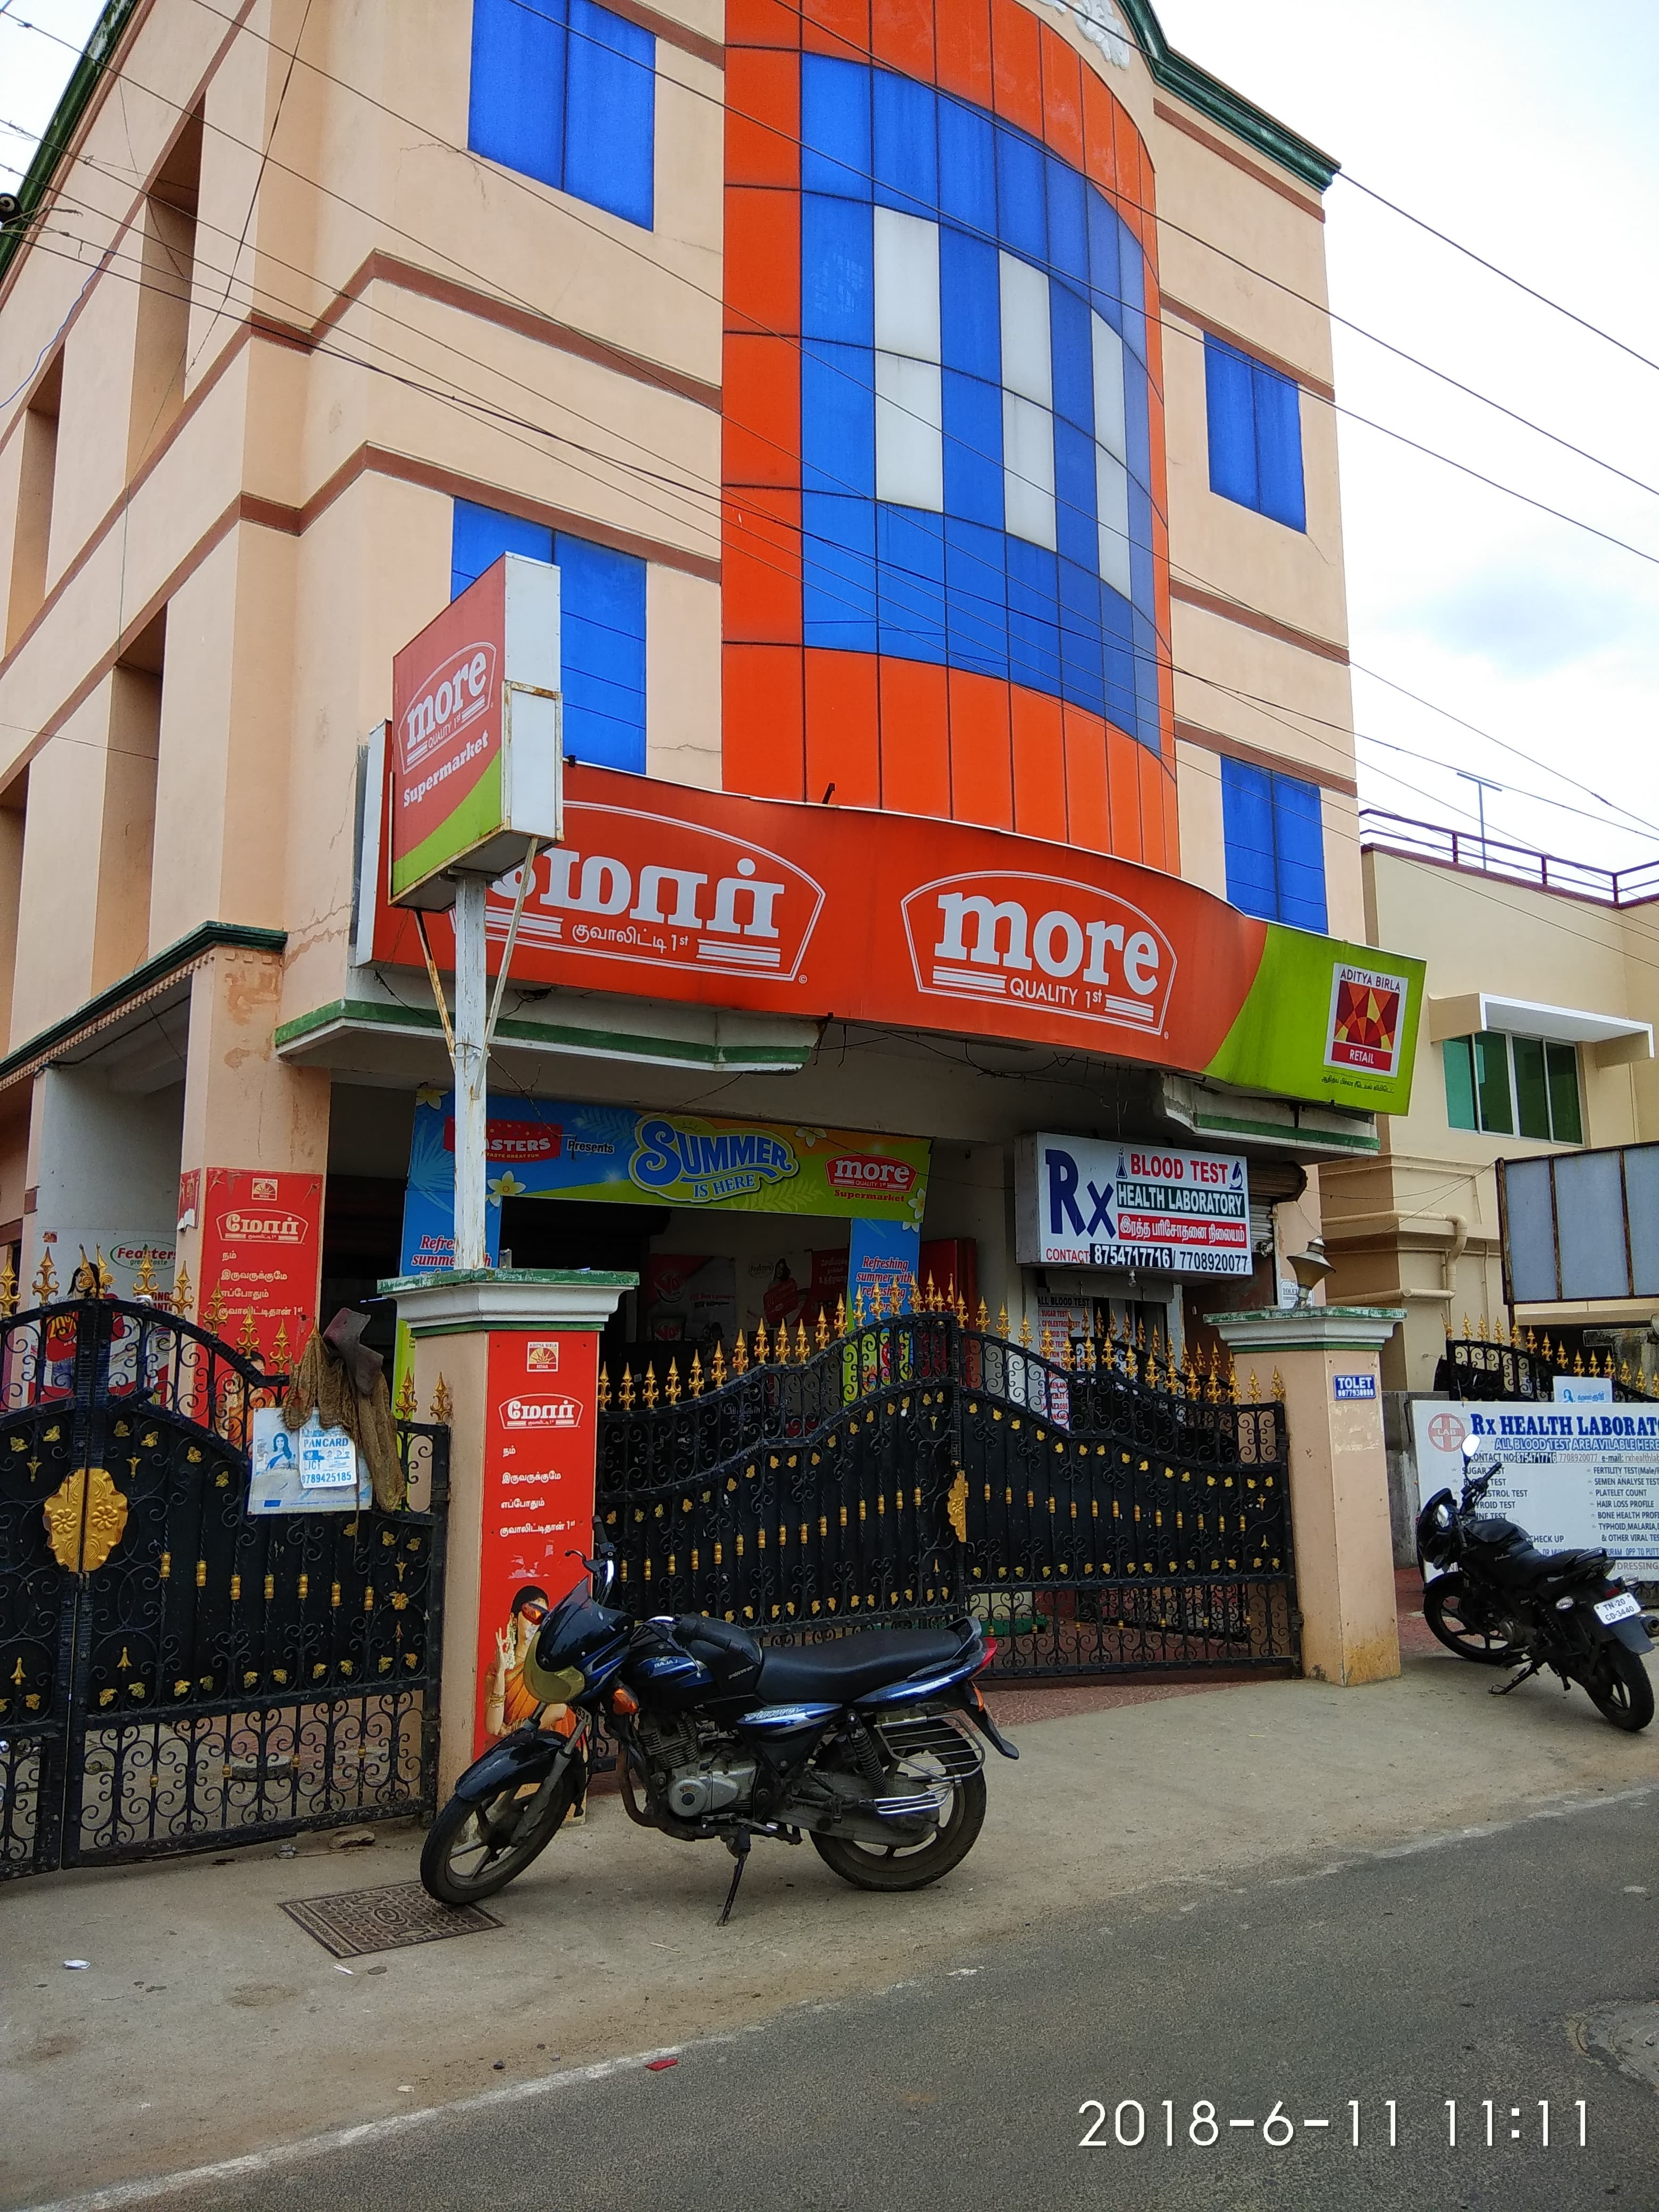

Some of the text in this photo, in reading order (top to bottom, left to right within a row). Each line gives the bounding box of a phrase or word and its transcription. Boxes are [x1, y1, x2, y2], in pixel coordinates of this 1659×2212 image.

[407, 652, 487, 750] more
[428, 723, 451, 749] QUALITY
[403, 730, 489, 808] Supermarket
[572, 923, 689, 954] குவாலிட்டி 1st
[934, 892, 1160, 996] more
[1340, 968, 1401, 992] ADITYA BIRLA
[1010, 977, 1103, 1009] QUALITY 1st
[1349, 1049, 1375, 1065] RETAIL
[485, 1137, 614, 1154] ASTERS Presents
[635, 1120, 793, 1186] SUMMER
[834, 1160, 910, 1183] more
[1130, 1153, 1228, 1185] BLOOD TEST
[693, 1174, 756, 1198] IS HERE
[834, 1189, 905, 1202] Supermarket
[1045, 1149, 1117, 1239] Rx
[1118, 1183, 1243, 1216] HEALTH LABORATORY
[226, 1213, 299, 1235] மோர்
[1120, 1215, 1245, 1245] இரத்த பரிசோதனை நிலையம்
[420, 1235, 455, 1254] Refre
[222, 1250, 237, 1261] நம்
[412, 1254, 455, 1267] summe
[862, 1255, 909, 1272] Refreshing
[1094, 1245, 1170, 1268] 8754717716
[1179, 1251, 1249, 1272] 7708920077
[221, 1269, 288, 1283] இருவருக்குமே
[856, 1272, 892, 1283] summer
[1037, 1296, 1090, 1306] ALL BLOOD TEST
[1337, 1377, 1372, 1389] TOLET
[507, 1400, 575, 1419] மோர்
[1470, 1413, 1659, 1436] Rx HEALTH LABORAT
[304, 1437, 349, 1448] PANCARD
[502, 1445, 516, 1457] நம்
[1495, 1438, 1513, 1451] ALL
[1514, 1438, 1547, 1451] BLOOD
[1547, 1438, 1571, 1451] TEST
[1572, 1438, 1591, 1451] ARE
[1592, 1438, 1636, 1451] AVILABLE
[1516, 1452, 1557, 1463] 8754717716
[1559, 1453, 1598, 1462] 7708920077
[1602, 1453, 1624, 1462] e-mail:
[502, 1470, 562, 1485] இருவருக்குமே
[501, 1497, 544, 1510] எப்போதும்
[1605, 1605, 1635, 1621] CD-3440
[654, 1659, 678, 1668] BAJAJ
